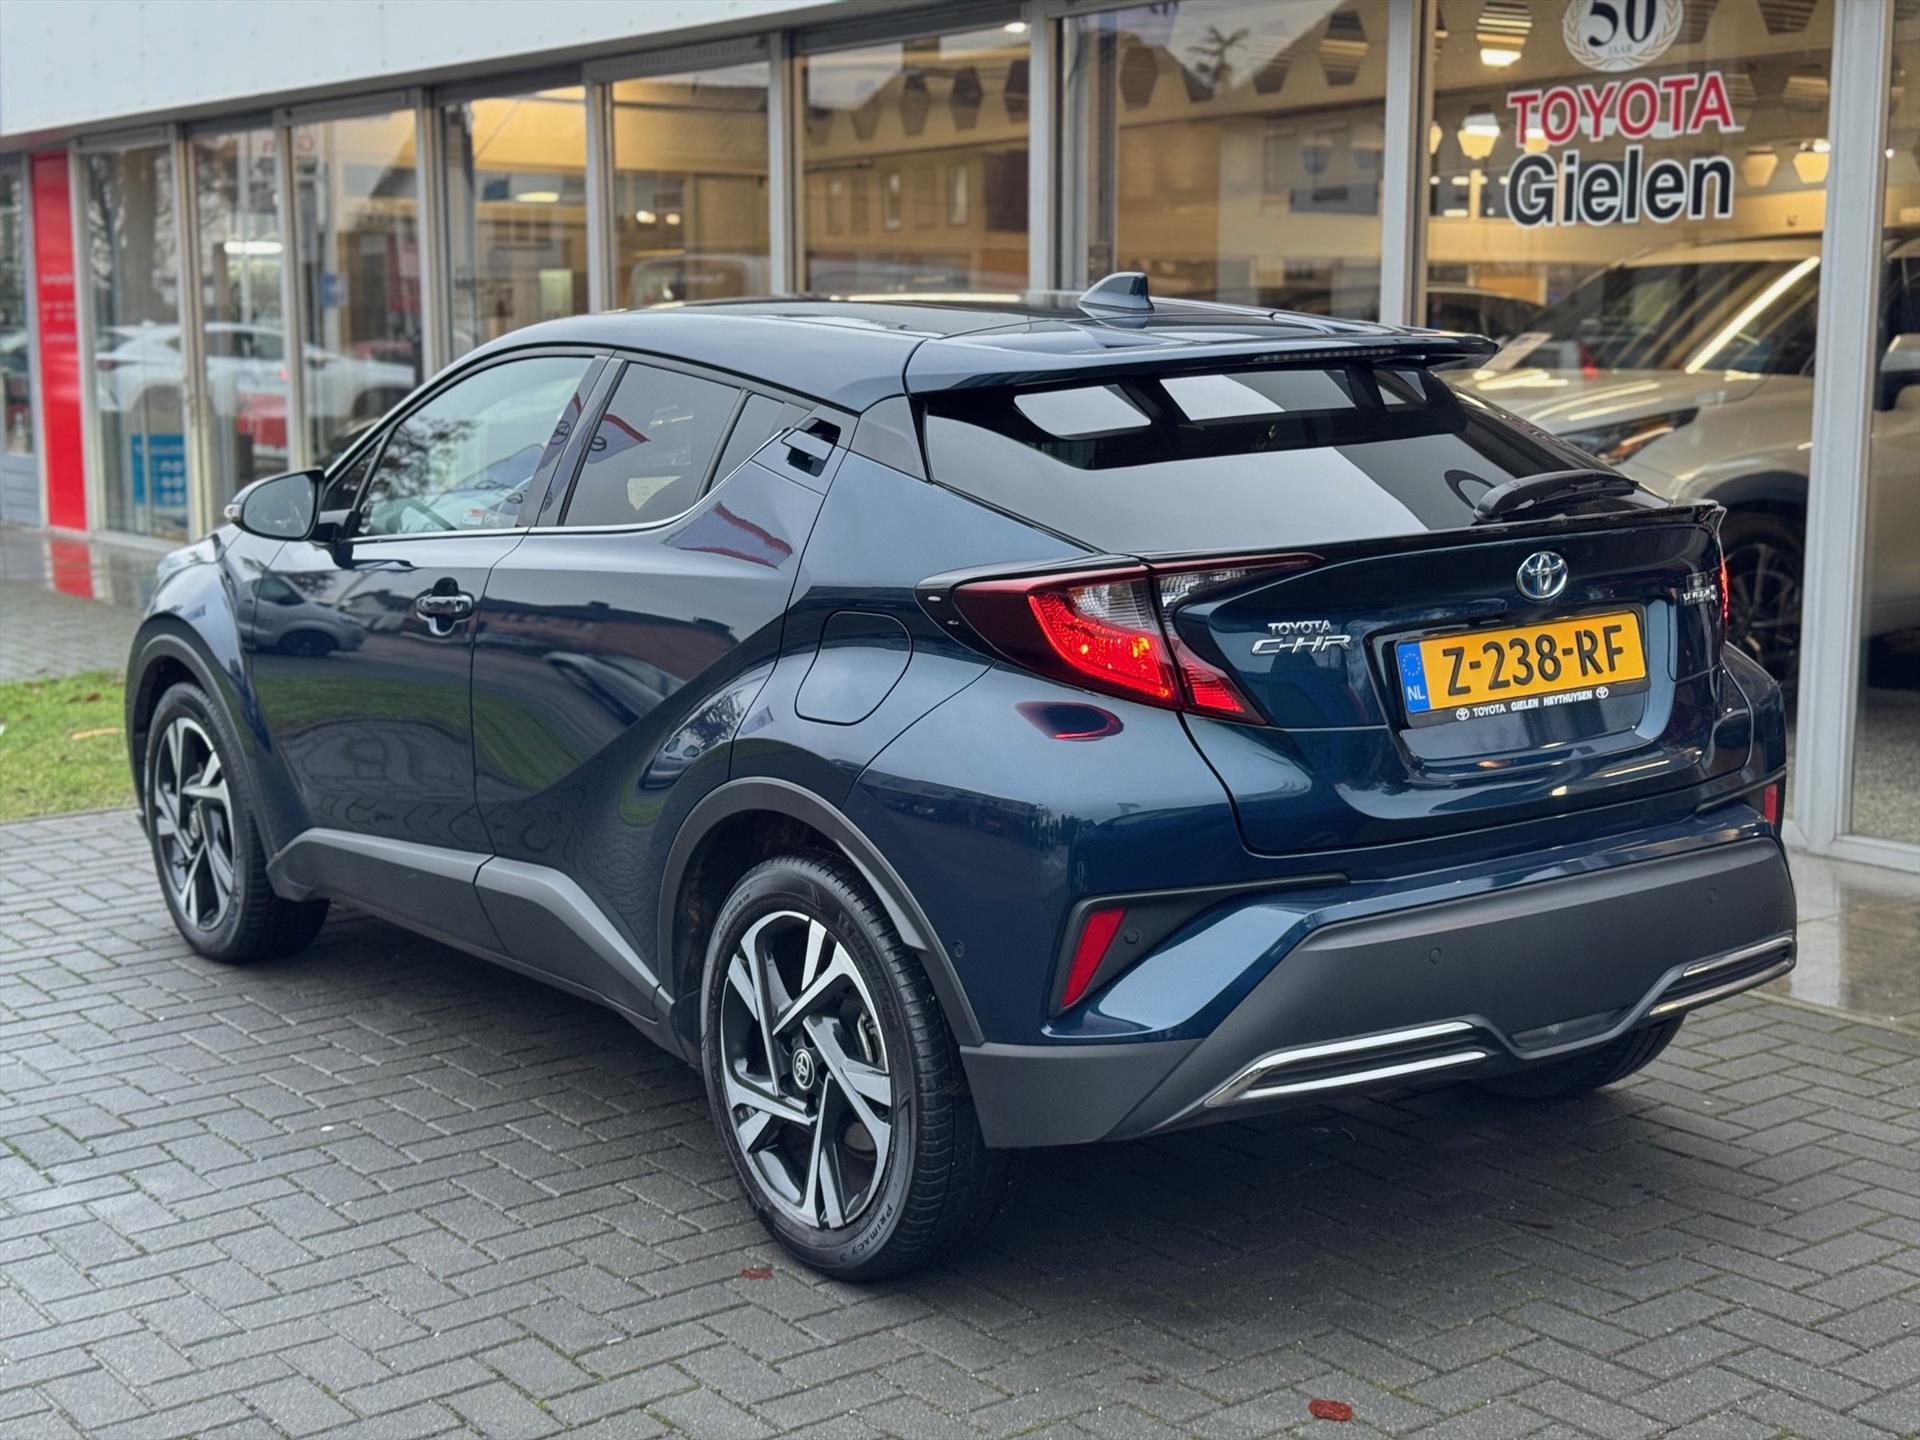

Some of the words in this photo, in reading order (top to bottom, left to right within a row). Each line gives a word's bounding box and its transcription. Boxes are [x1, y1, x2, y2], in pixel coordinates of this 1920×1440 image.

[1588, 0, 1656, 47] 50
[1508, 72, 1735, 147] TOYOTA
[1506, 146, 1734, 229] Gielen
[1251, 634, 1352, 656] C-HR
[1267, 619, 1333, 636] TOYOTA
[1442, 624, 1625, 697] Z-238-RF
[1407, 684, 1426, 701] NL
[1472, 703, 1506, 718] TOYOTA
[1511, 698, 1539, 711] GIELEN
[852, 1203, 893, 1256] PRIMACY
